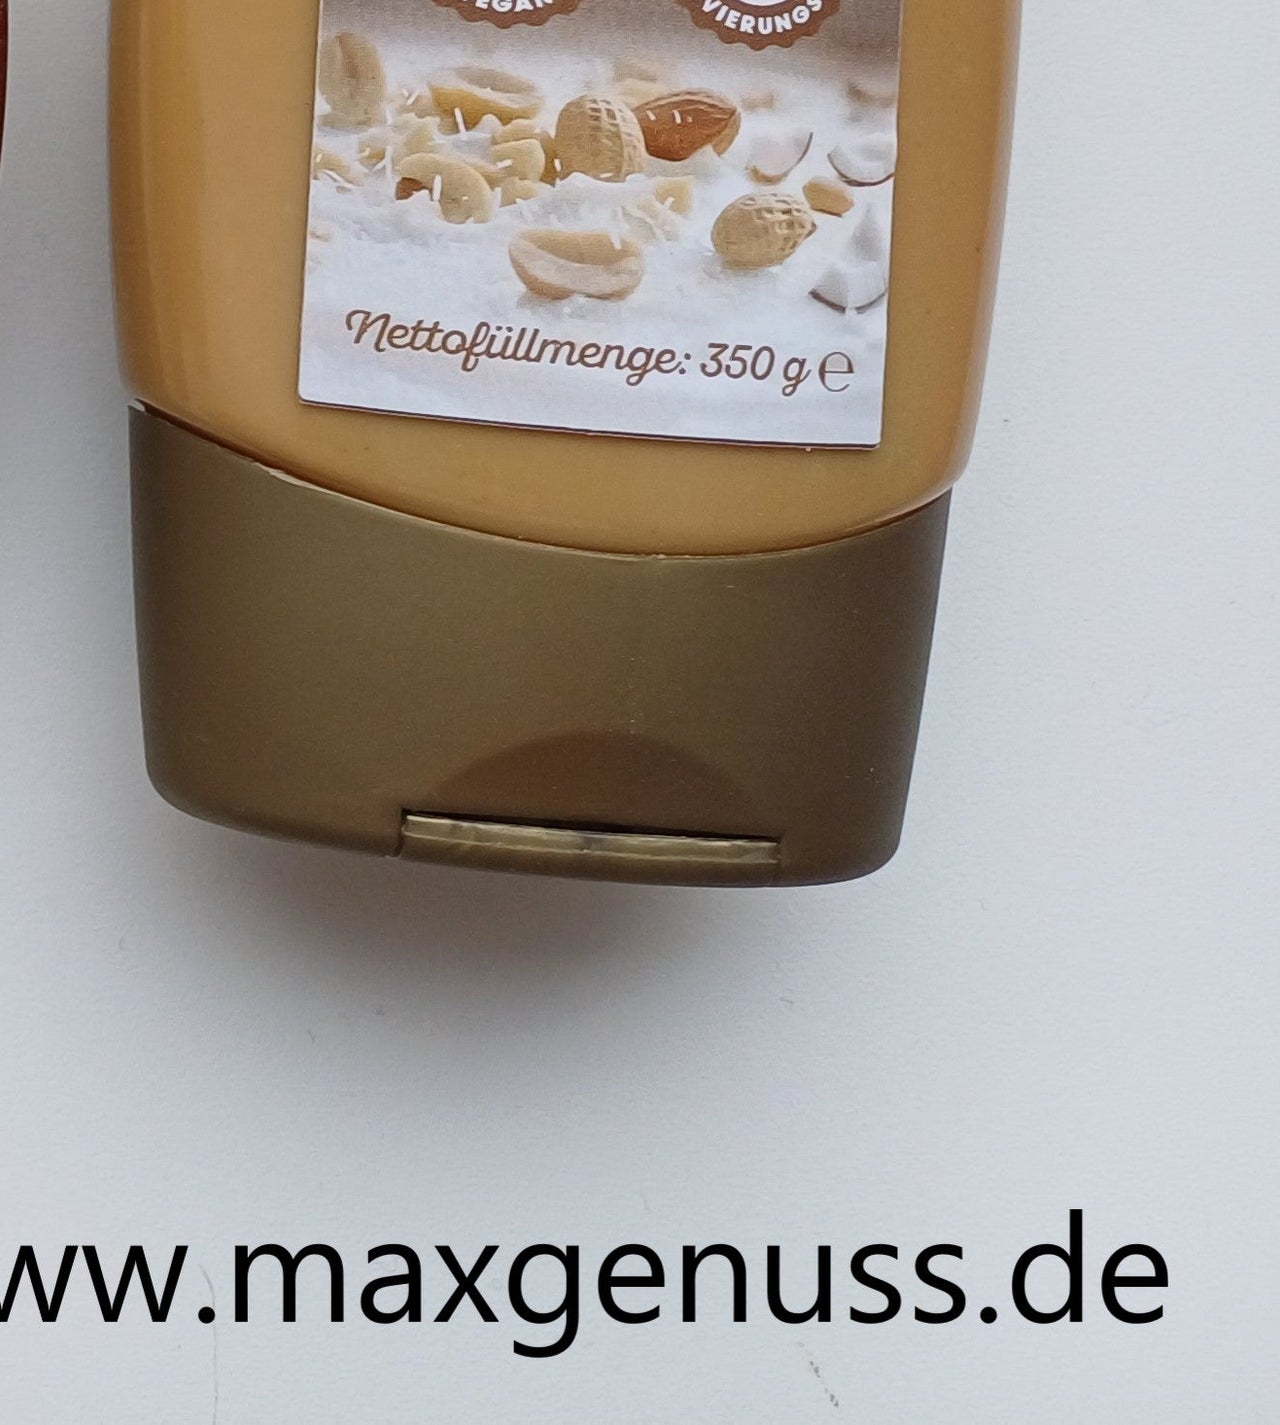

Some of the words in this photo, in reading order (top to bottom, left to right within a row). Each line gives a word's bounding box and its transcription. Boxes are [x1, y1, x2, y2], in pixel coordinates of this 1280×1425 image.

[345, 309, 692, 386] Nettofüllmenge:
[699, 343, 774, 381] 350
[782, 357, 811, 397] g
